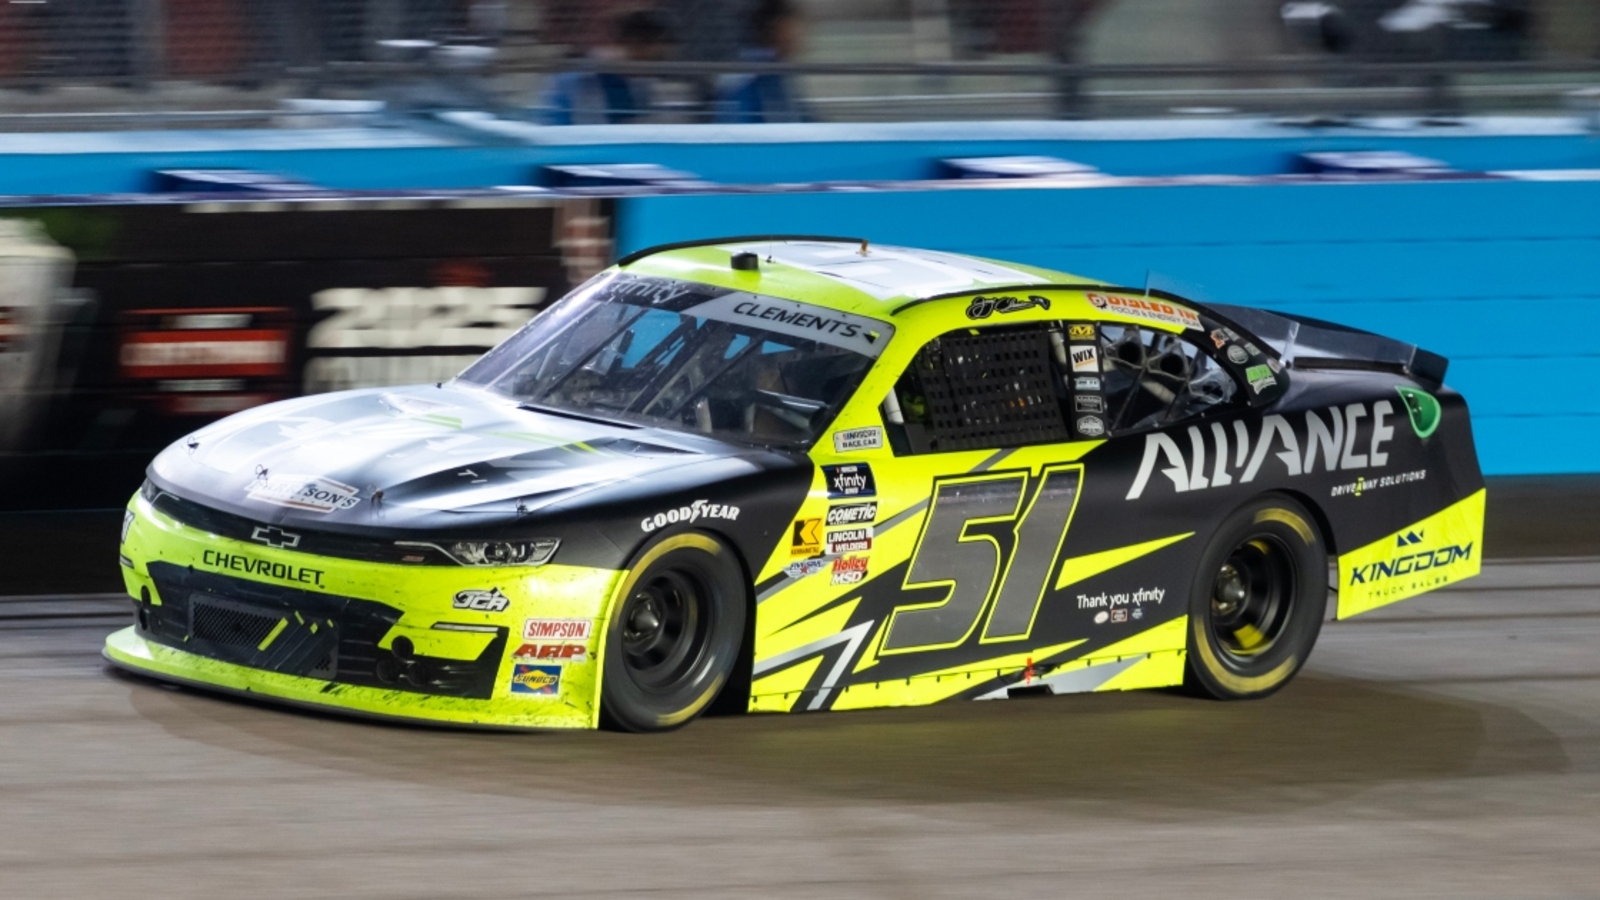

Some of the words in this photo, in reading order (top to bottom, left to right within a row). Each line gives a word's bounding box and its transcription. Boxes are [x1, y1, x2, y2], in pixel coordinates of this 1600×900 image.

[1110, 304, 1140, 317] FOCUS
[1176, 307, 1197, 321] IN
[733, 302, 862, 338] CLEMENTS
[1072, 347, 1095, 365] WIX
[862, 438, 877, 447] CAR
[1125, 400, 1395, 500] ALLIANCE
[833, 473, 867, 492] xfinity
[1379, 469, 1427, 488] SOLUTIONS
[640, 499, 741, 533] GOODYEAR
[828, 503, 876, 522] COMETIC
[828, 530, 866, 543] LINCOLN
[835, 541, 869, 553] WELDERS
[203, 549, 326, 587] CHEVROLET
[832, 555, 870, 573] Holley
[878, 463, 1085, 656] 51
[1350, 541, 1474, 587] KINGDOM
[830, 571, 864, 587] MSD
[1077, 591, 1108, 609] Thank
[1109, 593, 1130, 610] you
[1132, 586, 1165, 607] xfinity
[1368, 586, 1404, 599] TRUCK
[528, 621, 587, 638] SIMPSON
[513, 643, 586, 659] ARP
[515, 674, 558, 684] SUNOCO
